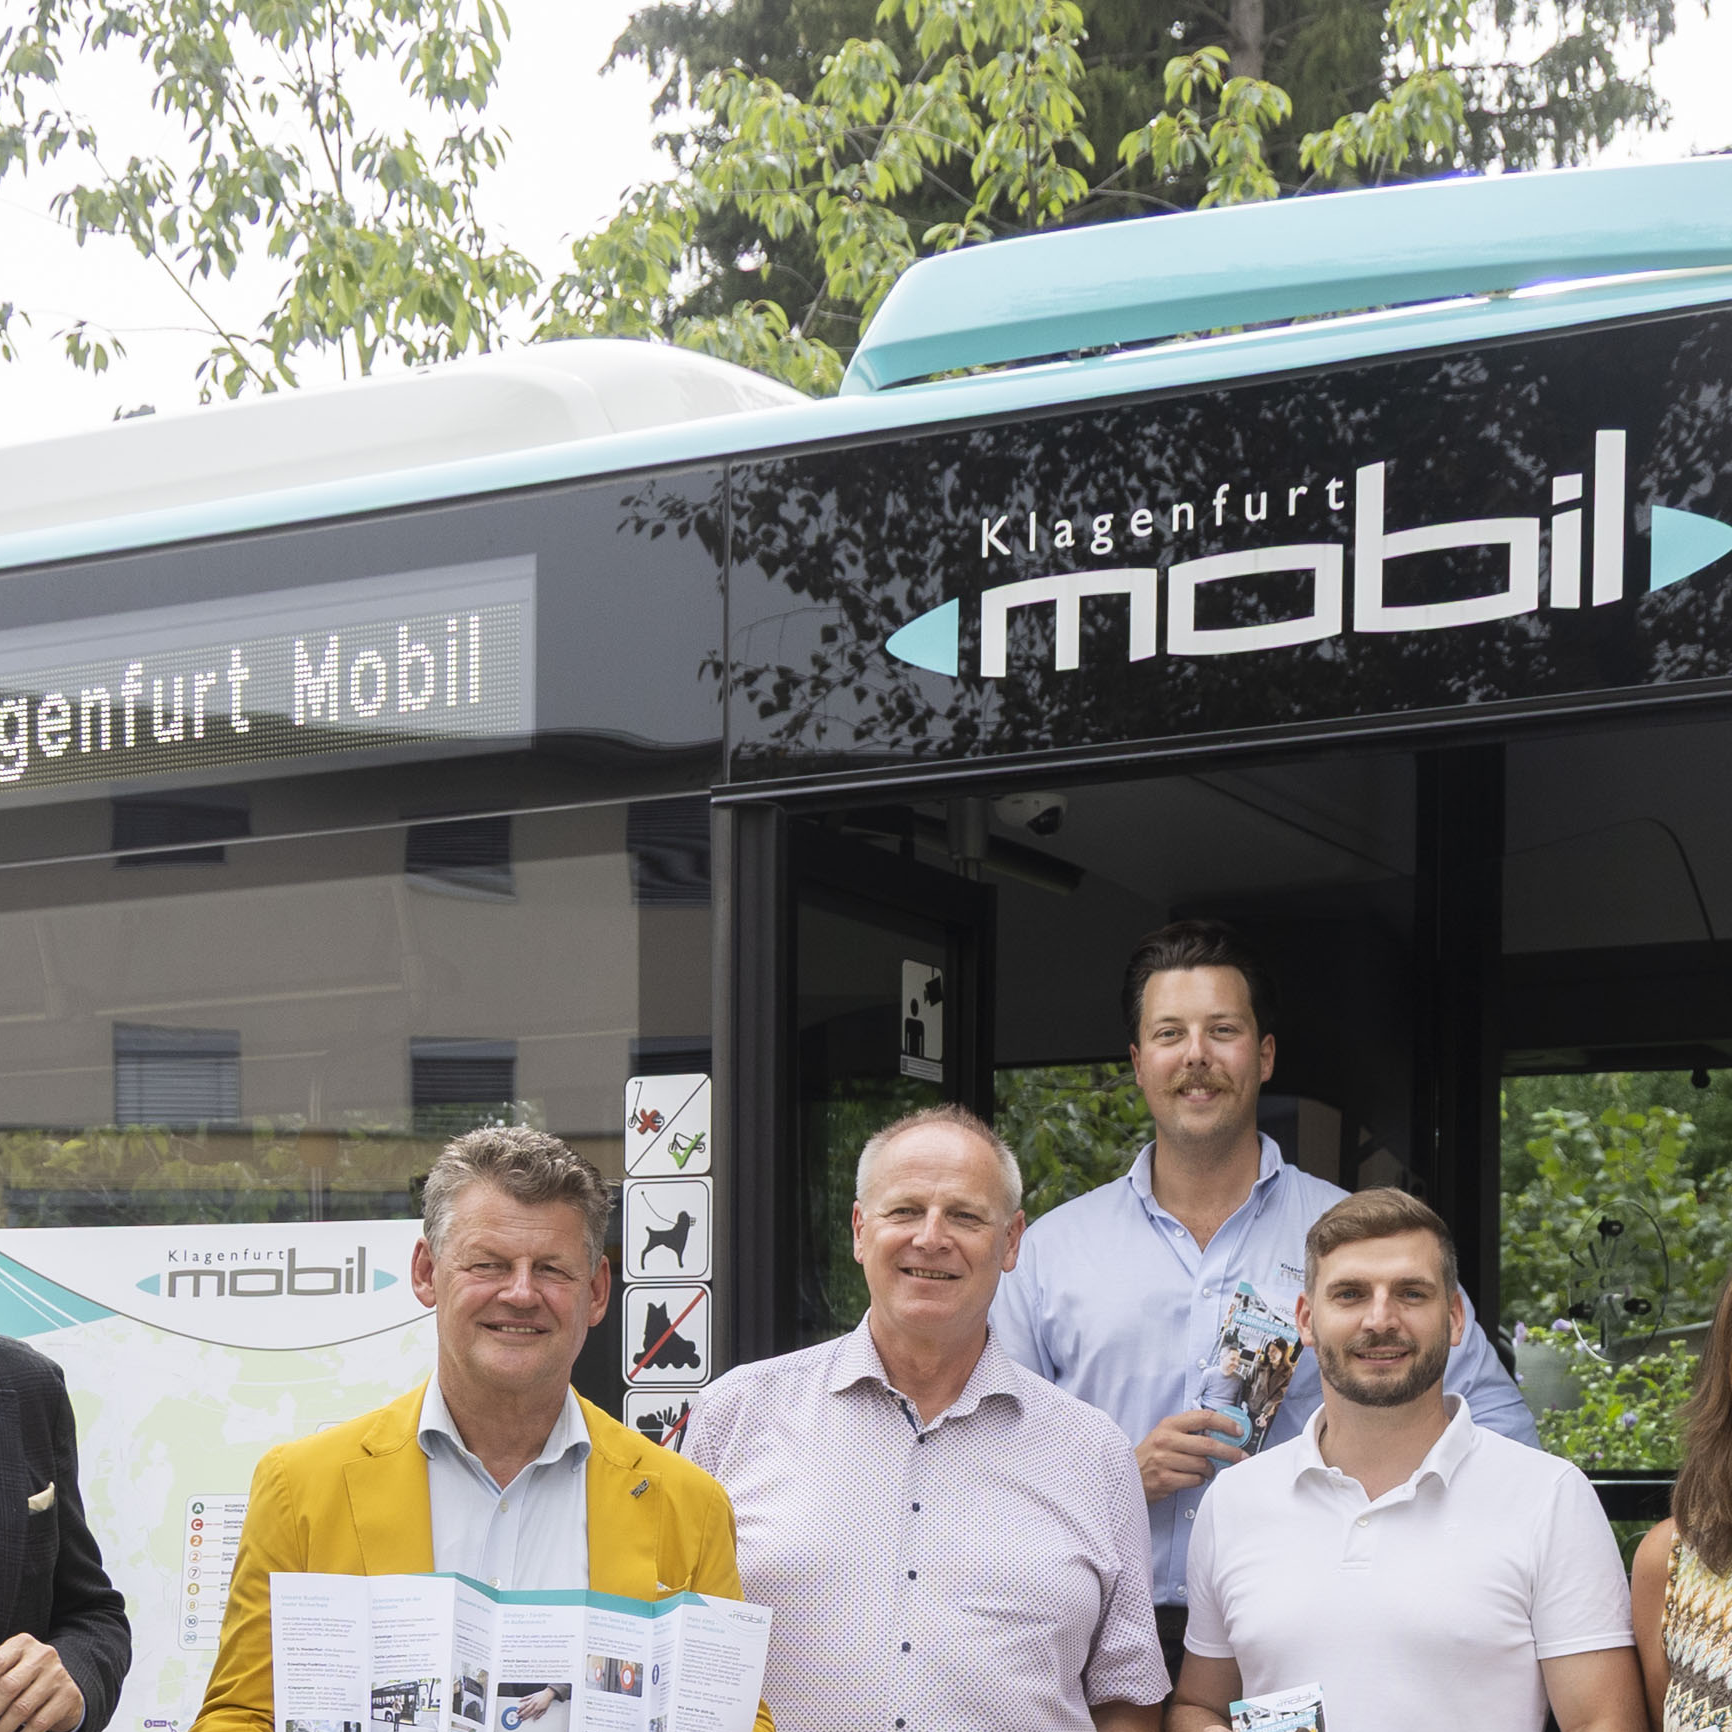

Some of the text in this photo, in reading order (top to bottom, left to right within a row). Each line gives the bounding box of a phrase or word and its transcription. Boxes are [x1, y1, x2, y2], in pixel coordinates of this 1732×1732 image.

[980, 476, 1345, 559] Klagenfurt
[980, 429, 1626, 678] mobil
[293, 614, 481, 727] Mobil
[168, 1248, 284, 1266] Klagenfurt
[168, 1246, 366, 1298] mobil
